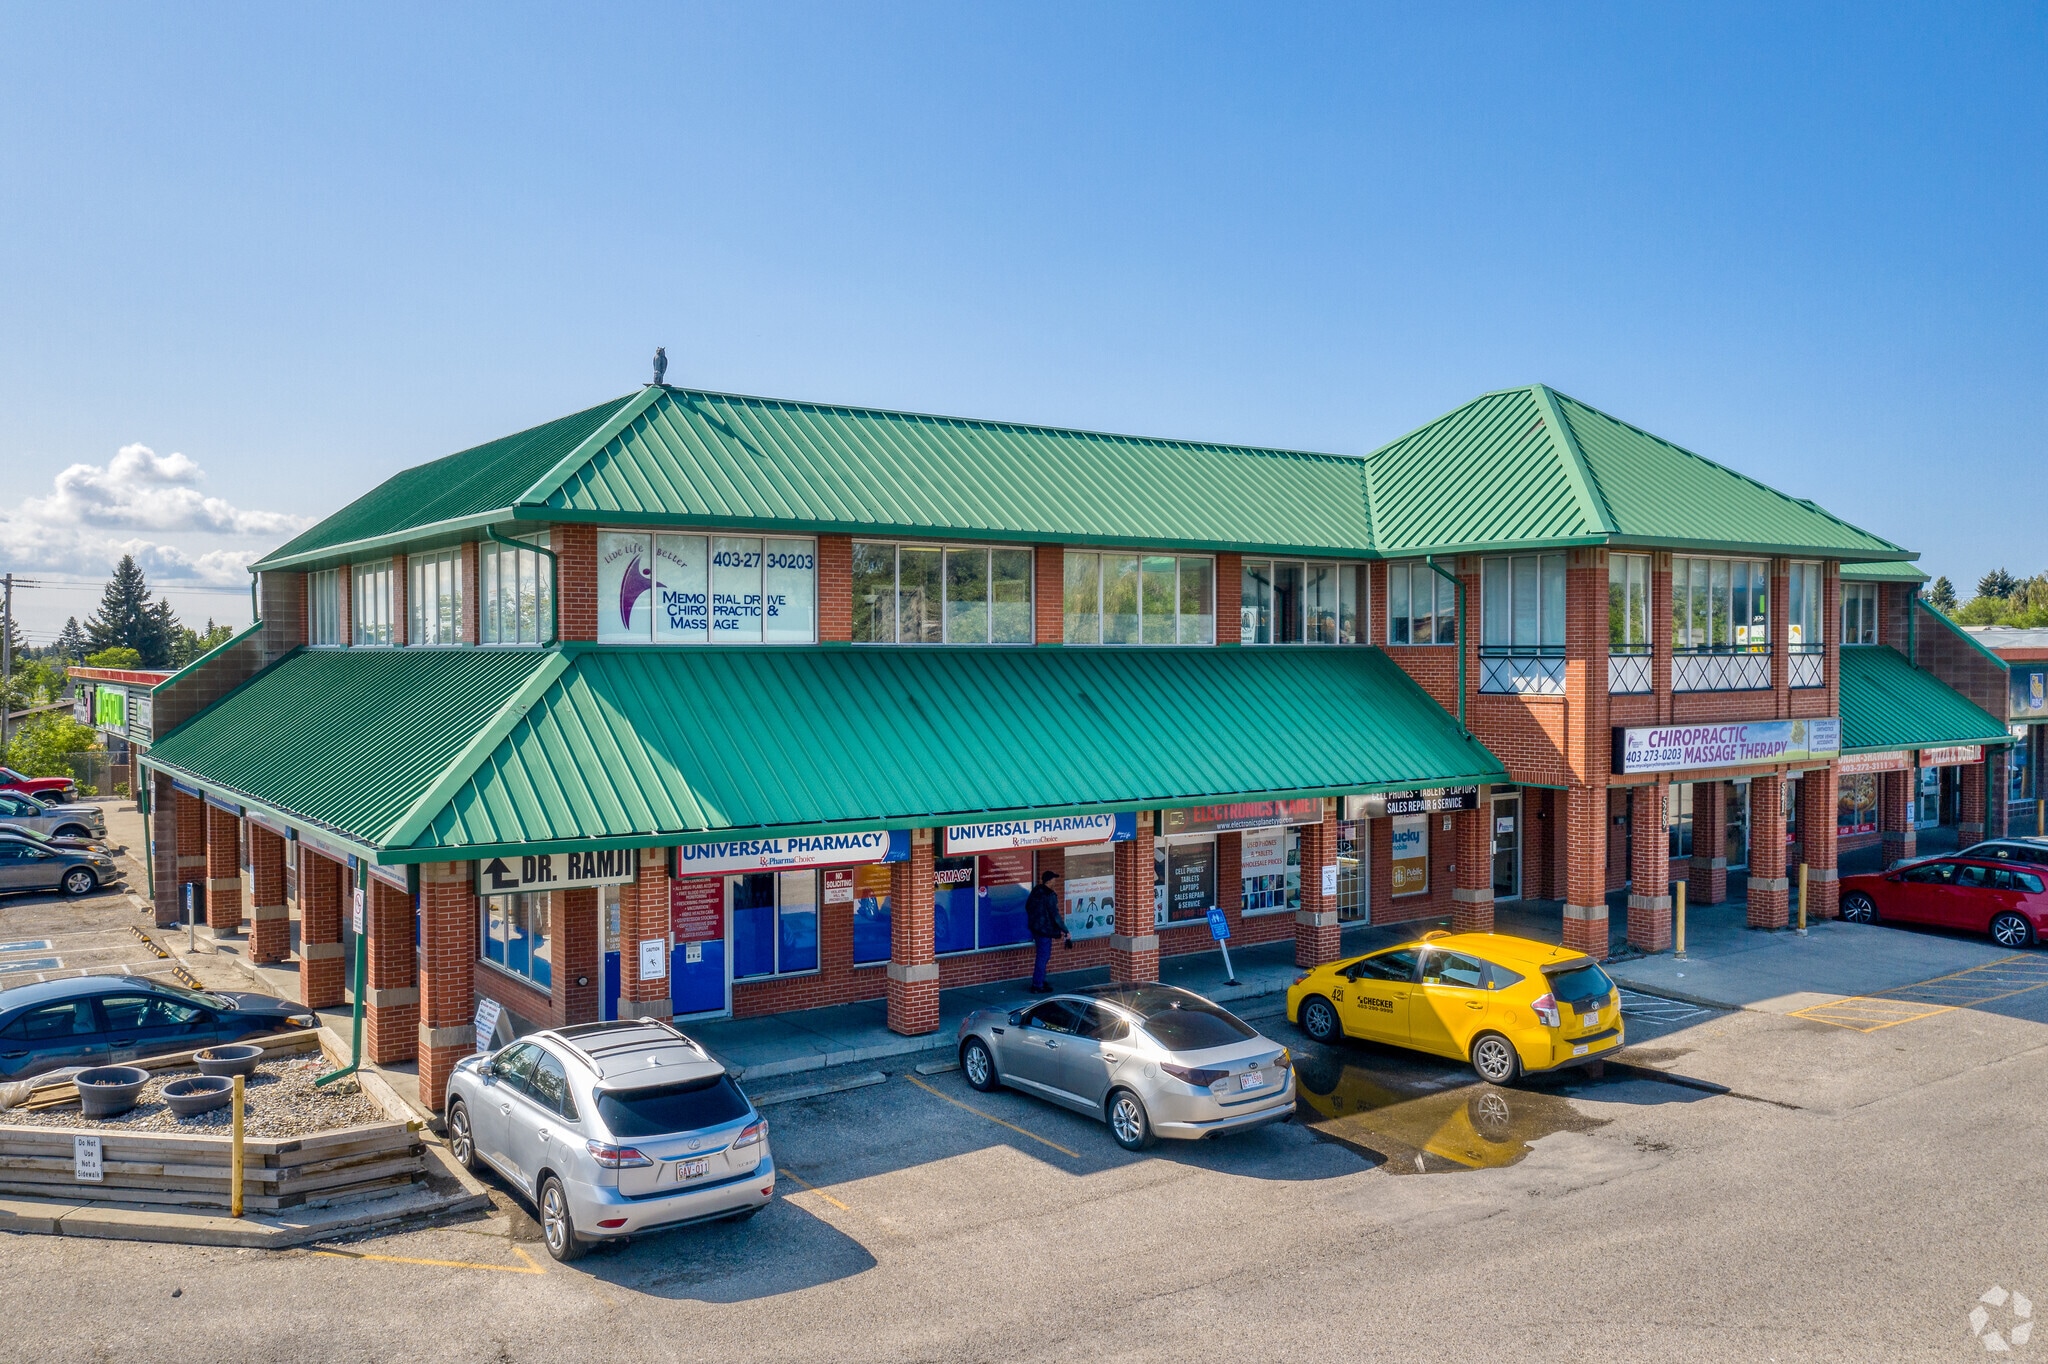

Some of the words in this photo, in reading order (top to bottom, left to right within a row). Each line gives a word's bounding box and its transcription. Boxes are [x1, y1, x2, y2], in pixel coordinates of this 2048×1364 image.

[713, 551, 814, 570] 403-273-0203
[743, 594, 787, 606] DRIVE
[767, 605, 779, 617] &
[670, 616, 739, 630] MASSAGE
[1648, 725, 1748, 748] CHIROPRACTIC
[1626, 750, 1642, 762] 403
[1644, 748, 1682, 762] 273-0203
[1683, 744, 1736, 764] MASSAGE
[1740, 740, 1788, 759] THERAPY
[1193, 799, 1274, 823] ELECTRONICS
[1274, 797, 1318, 815] PLANET
[1387, 801, 1408, 814] SALES
[1408, 799, 1432, 812] REPAIR
[1432, 799, 1437, 809] &
[1438, 797, 1463, 809] SERVICE
[949, 822, 1030, 841] UNIVERSAL
[1034, 814, 1112, 833] PHARMACY
[1392, 829, 1420, 844] lucky
[683, 840, 783, 861] UNIVERSAL
[787, 833, 883, 853] PHARMACY
[1246, 841, 1259, 849] USED
[1259, 839, 1277, 847] PHONES
[1255, 849, 1274, 857] TABLETS
[522, 855, 558, 884] DR.
[567, 849, 632, 881] RAMJI
[1241, 859, 1267, 869] WHOLESALE
[1267, 858, 1283, 866] PRICES
[835, 872, 843, 880] NO
[933, 867, 973, 885] ARMACY
[1175, 867, 1186, 875] CELL
[1186, 866, 1204, 874] PHONES
[826, 879, 852, 889] SOLICITING
[1181, 874, 1200, 883] TABLETS
[1180, 883, 1200, 892] LAPTOPS
[1174, 892, 1188, 901] SALES
[1188, 891, 1205, 899] REPAIR
[1182, 900, 1201, 908] SERVICE
[1331, 988, 1344, 1003] 421
[1363, 996, 1394, 1009] CHECKER
[77, 1170, 100, 1178] Sidewalk
